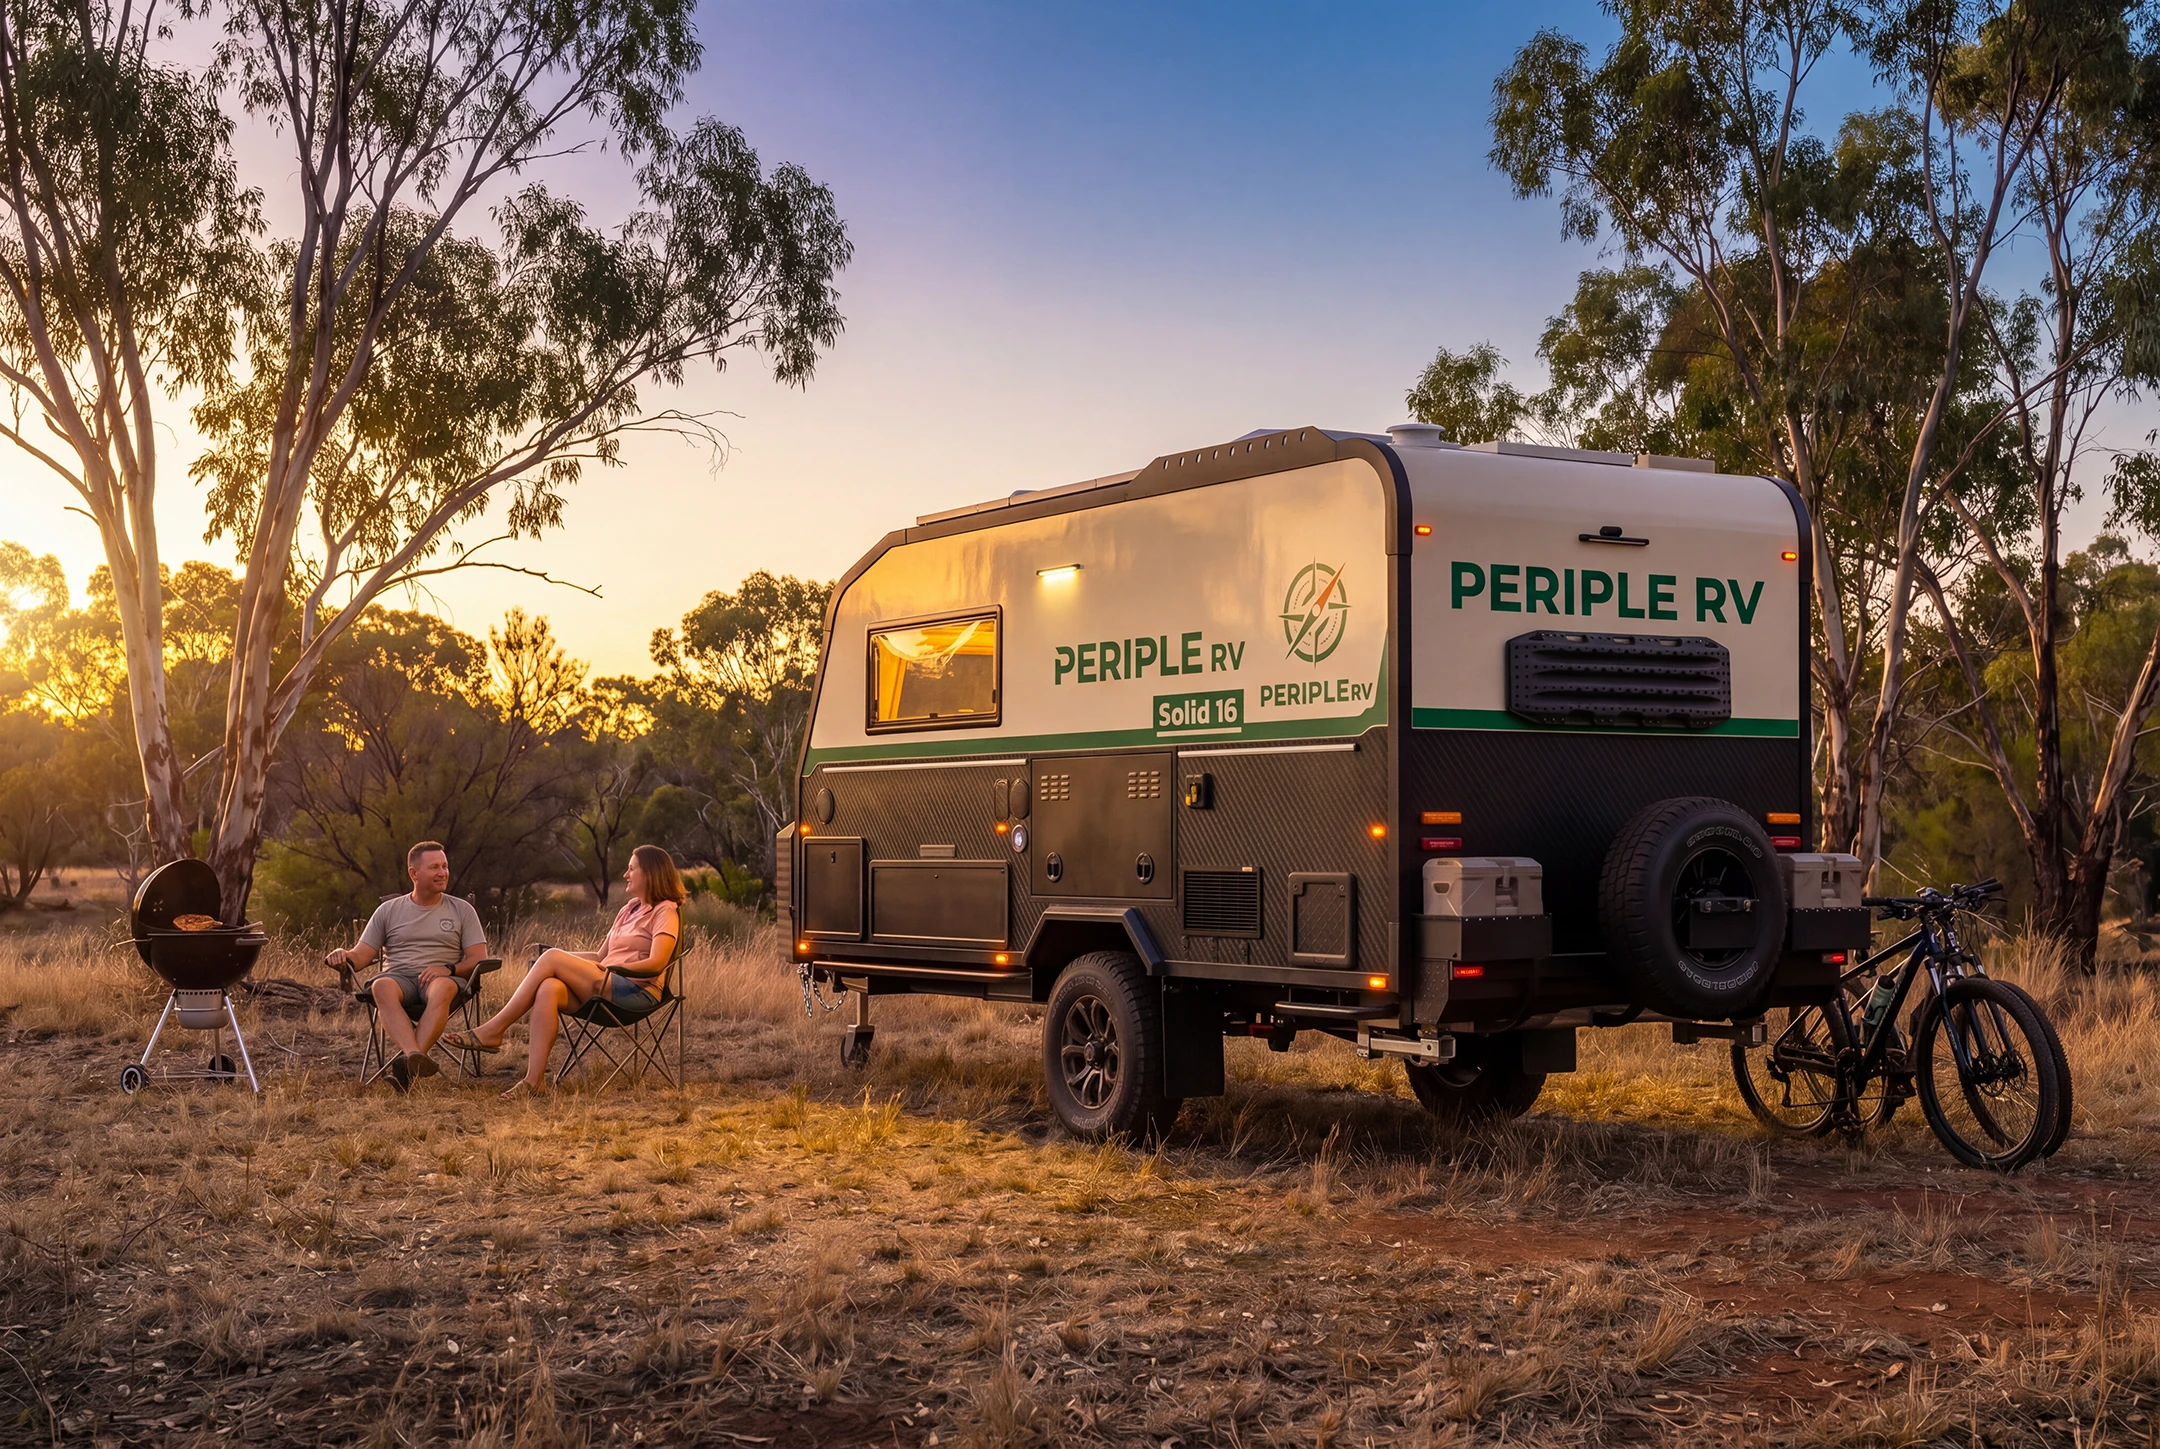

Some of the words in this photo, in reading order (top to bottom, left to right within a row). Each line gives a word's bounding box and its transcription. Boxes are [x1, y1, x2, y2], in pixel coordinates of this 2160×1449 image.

[1451, 561, 1678, 621] PERIPLE
[1696, 577, 1765, 625] RV
[1054, 631, 1203, 686] PERIPLE
[1211, 640, 1246, 672] RV
[1158, 699, 1210, 727] Solid
[1216, 697, 1238, 723] 16
